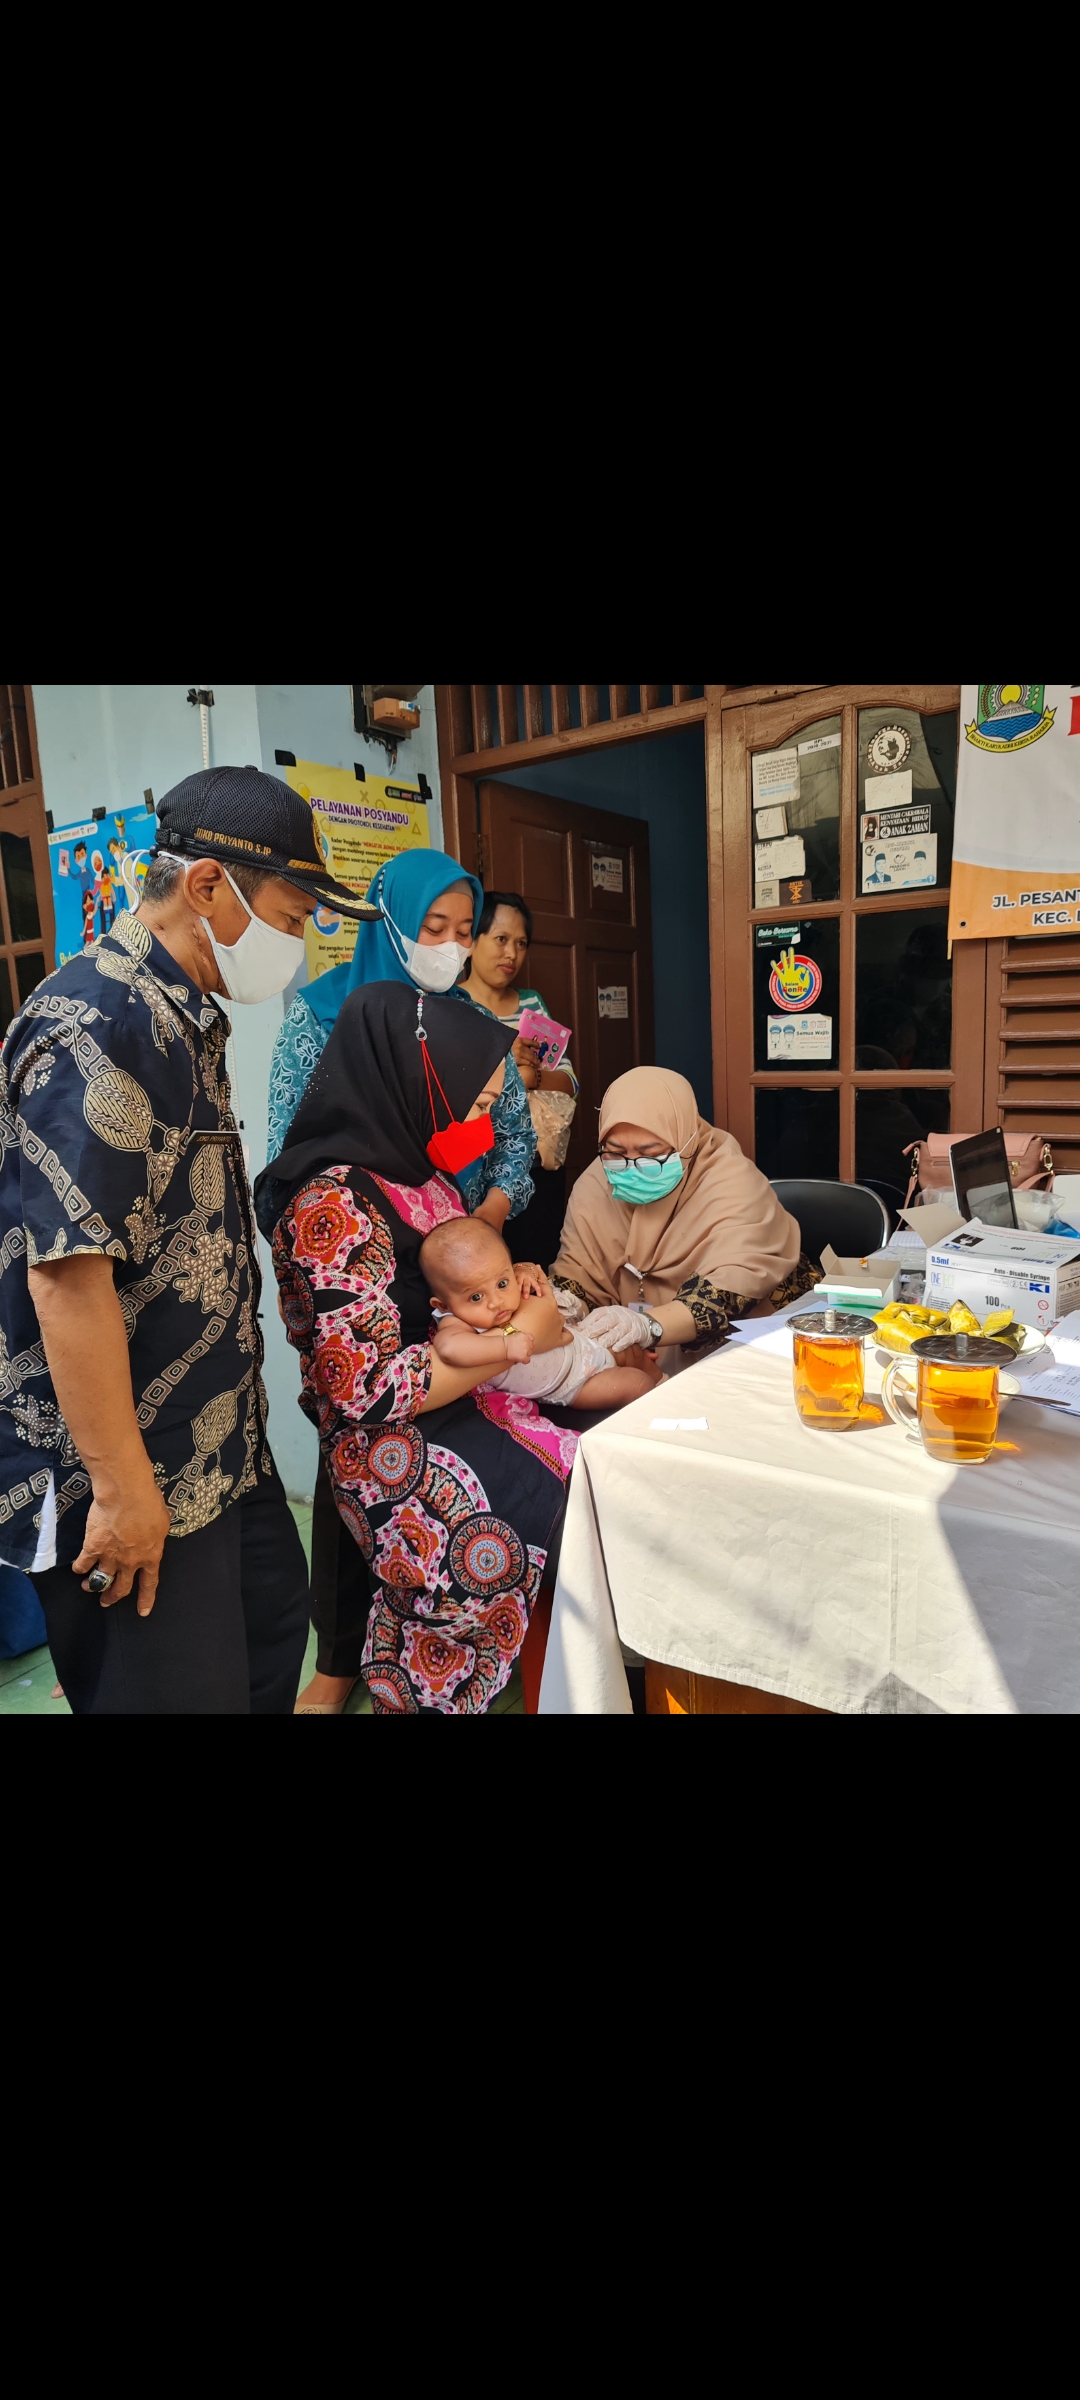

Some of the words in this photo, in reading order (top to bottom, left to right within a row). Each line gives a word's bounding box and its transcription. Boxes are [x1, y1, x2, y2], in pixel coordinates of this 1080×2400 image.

[310, 797, 362, 818] PELAYANAN
[364, 806, 409, 825] POSYANDU
[328, 815, 348, 825] DENGAN
[347, 818, 372, 829] PROTOKOL
[372, 822, 395, 832] KESEHATAN
[911, 814, 929, 823] HIDUP
[891, 825, 906, 836] ANAK
[906, 822, 928, 834] ZAMAN
[194, 827, 212, 840] JOKO
[213, 832, 253, 852] PRIYANTO
[255, 844, 272, 856] S.IP
[992, 896, 1015, 908] JL.
[1033, 911, 1072, 925] KEC.
[931, 1255, 949, 1265] 0.5ml
[994, 1267, 1006, 1275] Auto
[1009, 1269, 1029, 1279] Disable
[1029, 1271, 1051, 1282] Syringe
[985, 1295, 1000, 1307] 100
